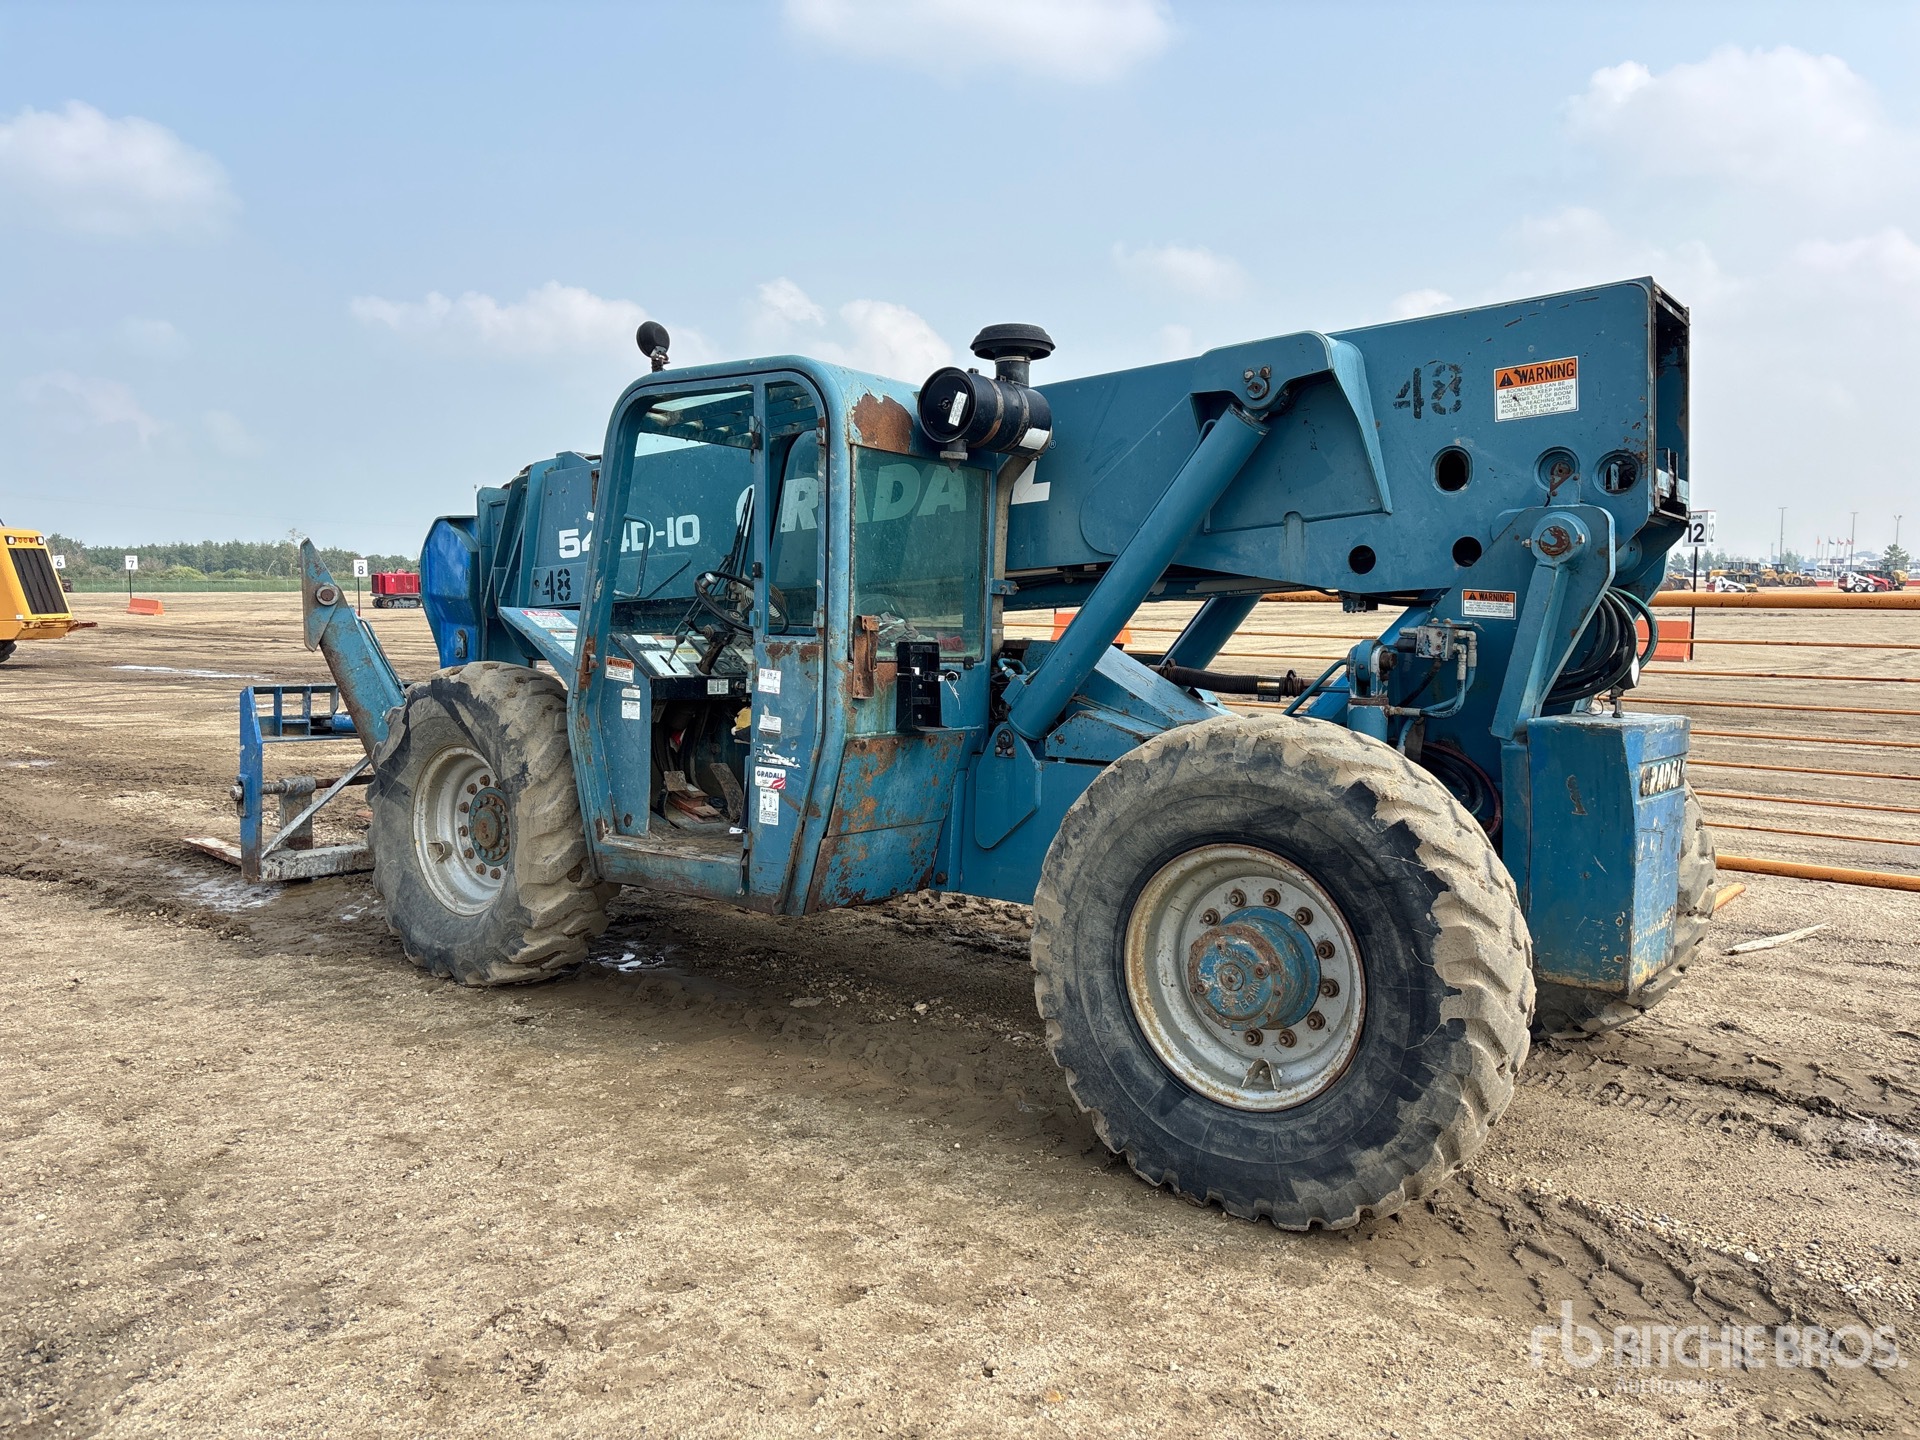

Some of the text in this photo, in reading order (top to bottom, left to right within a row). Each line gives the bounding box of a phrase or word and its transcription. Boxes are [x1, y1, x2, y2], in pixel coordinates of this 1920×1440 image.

[1519, 362, 1575, 384] WARNING
[1393, 363, 1463, 420] 48
[735, 460, 1051, 537] RDAL
[1688, 522, 1705, 543] 12
[1708, 523, 1714, 542] 12
[128, 560, 135, 568] 7
[358, 566, 364, 574] 8
[542, 568, 572, 602] 48
[1479, 592, 1510, 602] WARNING
[757, 770, 783, 779] GRADALL
